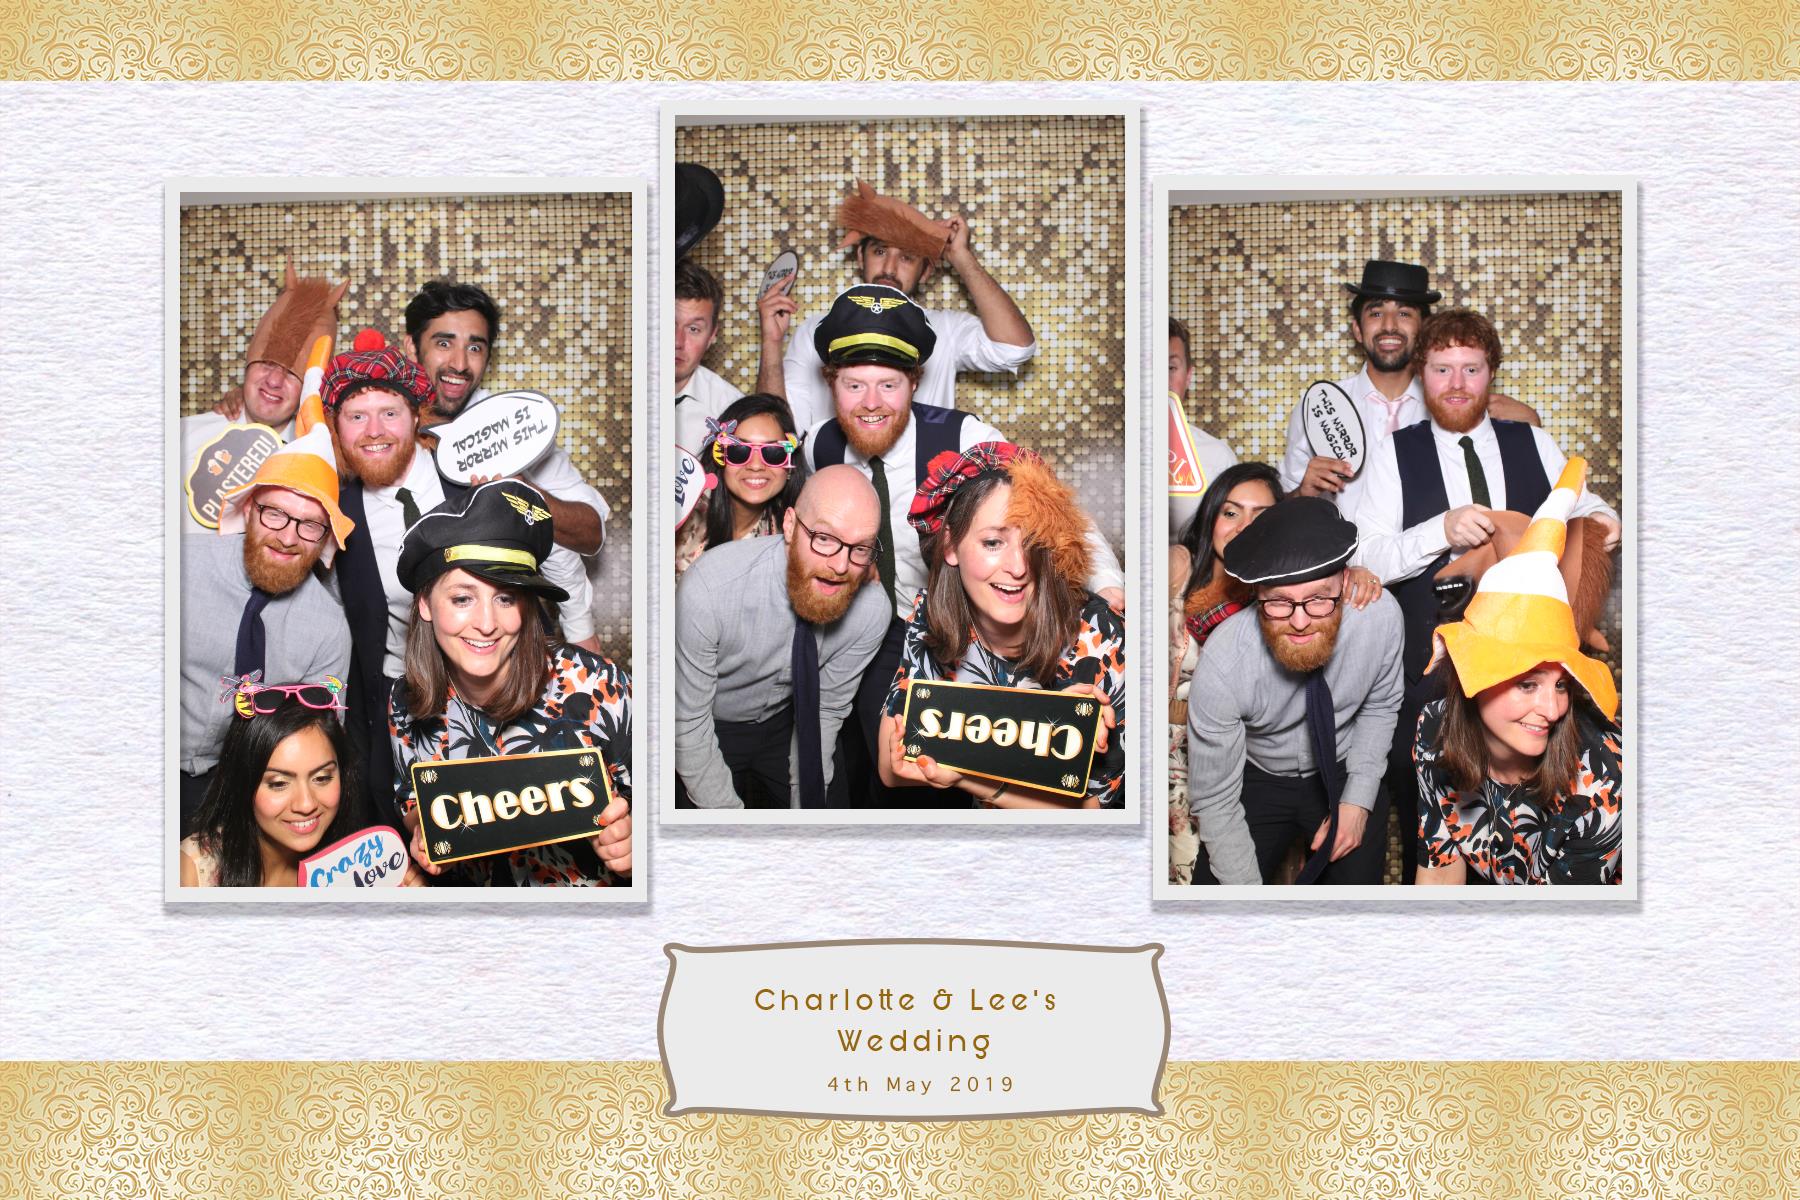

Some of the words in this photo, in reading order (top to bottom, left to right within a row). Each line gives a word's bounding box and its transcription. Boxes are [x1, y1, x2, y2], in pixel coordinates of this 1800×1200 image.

[514, 405, 531, 425] IS
[1311, 404, 1324, 418] IS
[1319, 389, 1336, 415] THIS
[1332, 417, 1358, 458] MIRROR
[452, 416, 510, 454] MAGICAL
[513, 419, 548, 446] THIS
[456, 437, 509, 472] MIRROR
[919, 708, 1084, 761] Cheers
[430, 776, 596, 830] Cheers
[310, 834, 385, 887] Crazy
